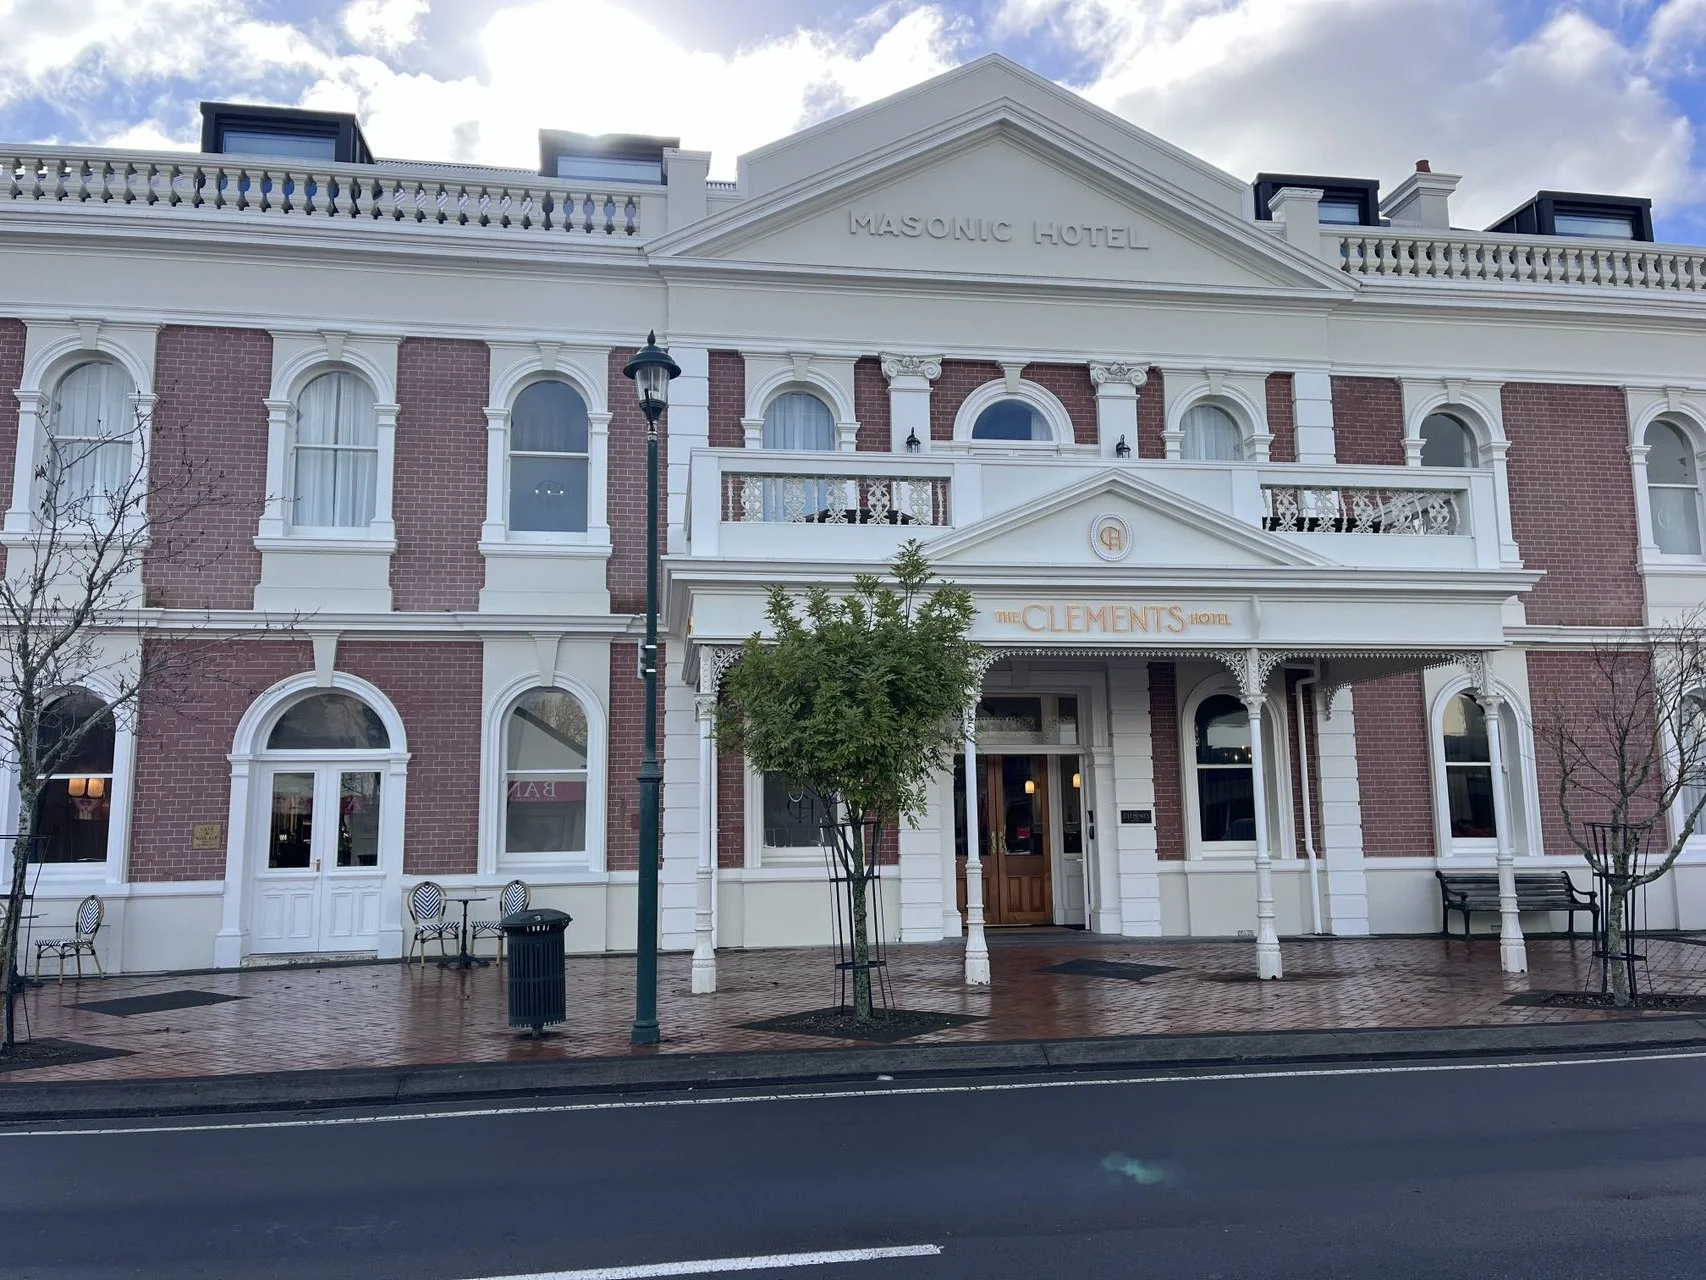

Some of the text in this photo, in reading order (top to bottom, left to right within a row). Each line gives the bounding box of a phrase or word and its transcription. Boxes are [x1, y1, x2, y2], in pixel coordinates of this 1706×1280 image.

[849, 209, 1149, 250] MASONIC HOTEL
[994, 602, 1232, 633] THE CLEMENTS HOTEL
